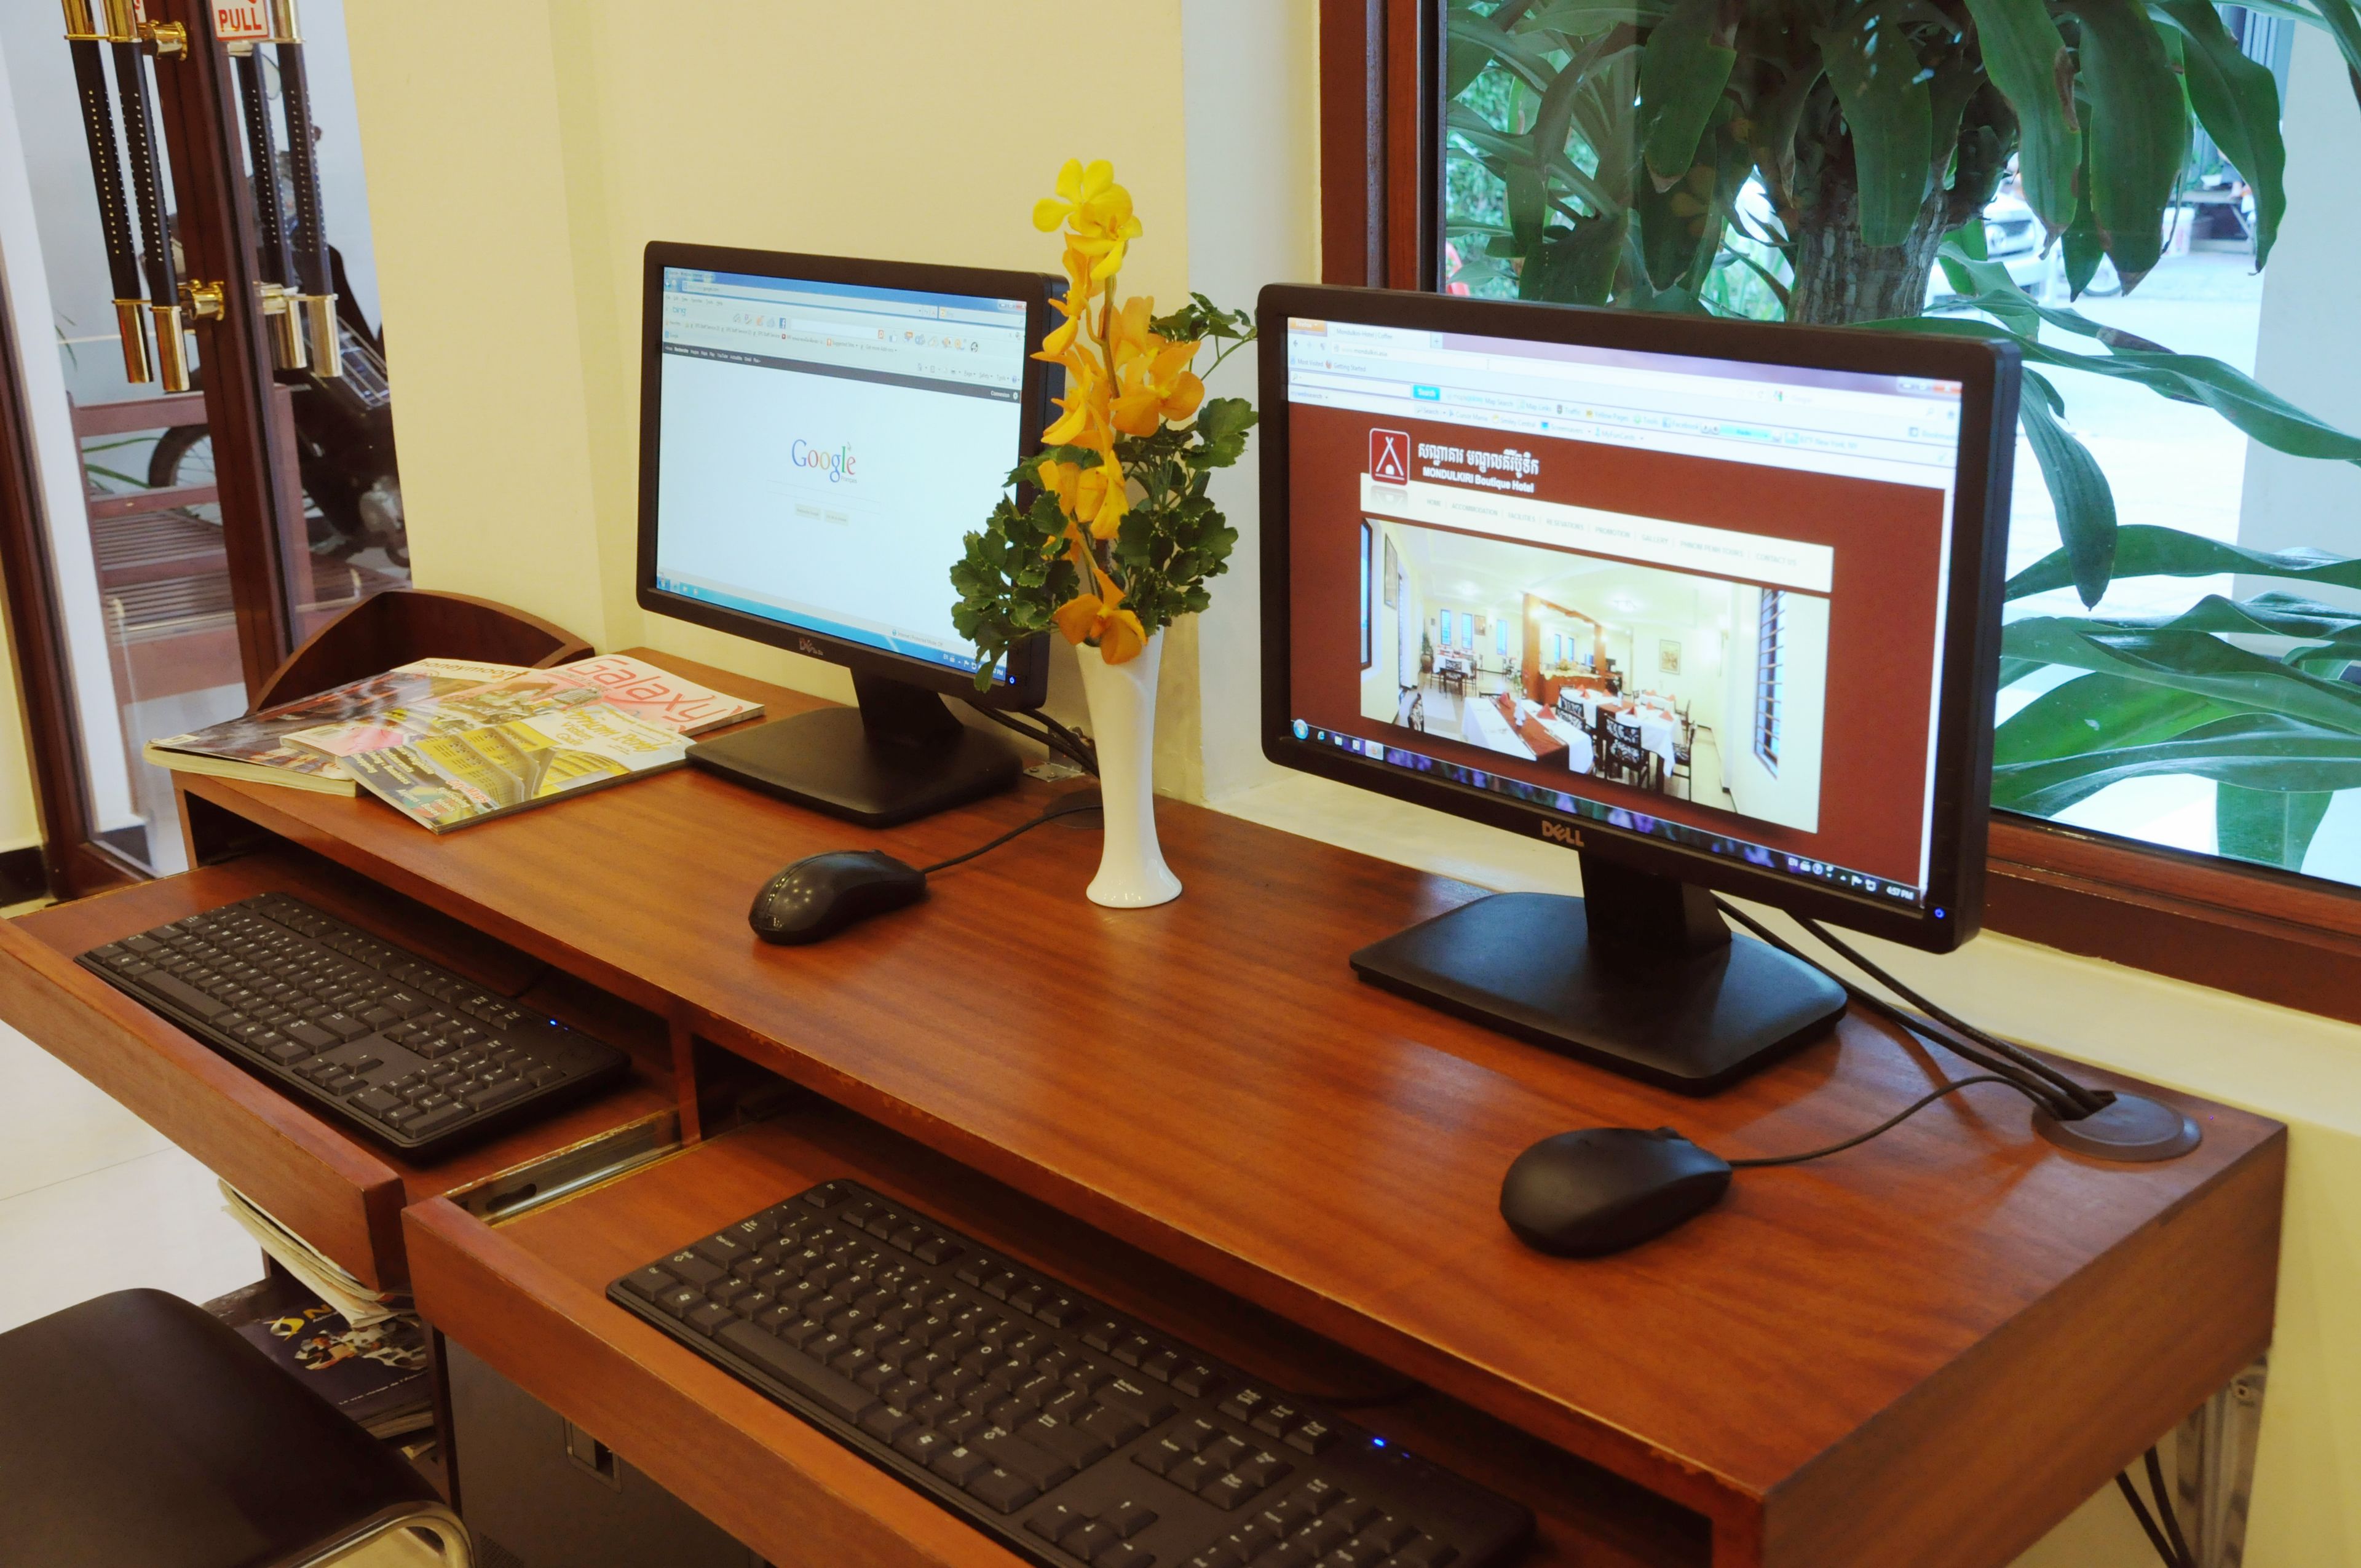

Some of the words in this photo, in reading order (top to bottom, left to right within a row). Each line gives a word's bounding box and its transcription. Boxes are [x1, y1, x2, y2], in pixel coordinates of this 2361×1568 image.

[218, 7, 263, 33] PULL
[791, 438, 856, 483] Google
[1422, 466, 1474, 484] MONDULKIRI
[1475, 474, 1511, 490] Boutique
[1512, 480, 1535, 493] Hotel
[567, 657, 729, 723] Galaxy
[1541, 820, 1584, 847] DELL
[1901, 889, 1915, 901] PM
